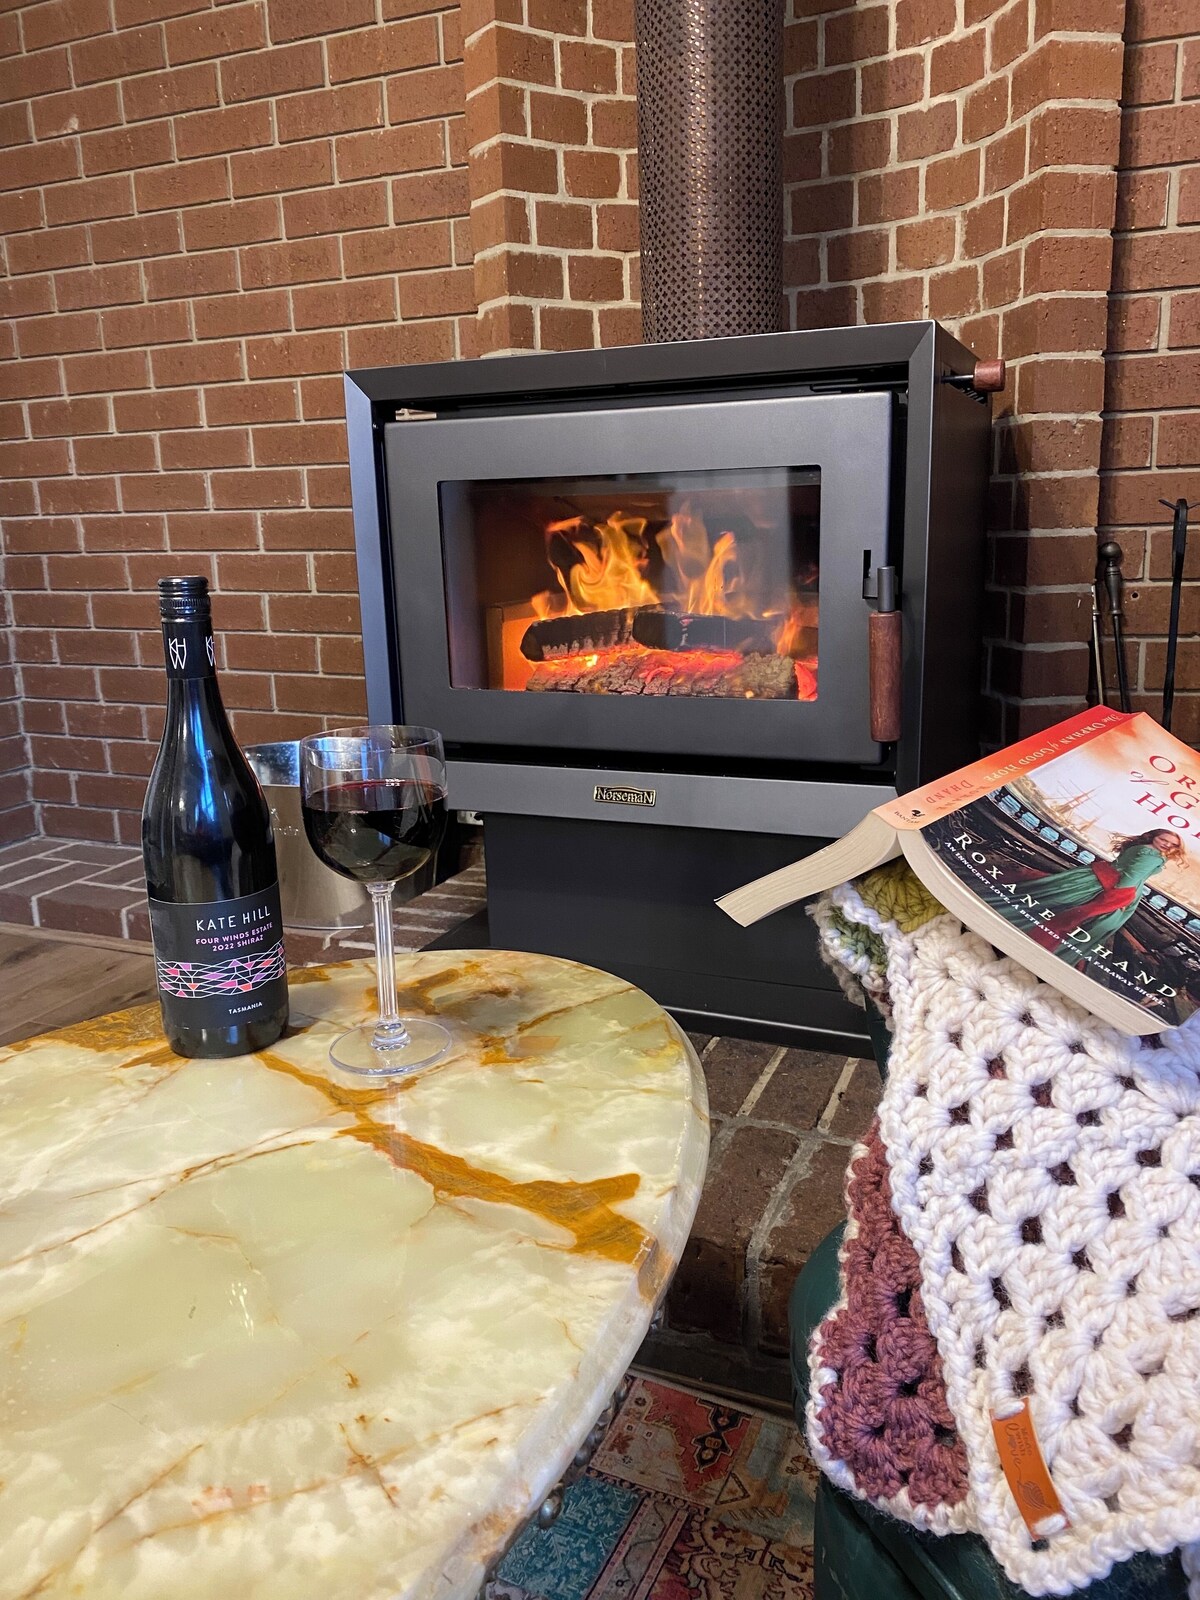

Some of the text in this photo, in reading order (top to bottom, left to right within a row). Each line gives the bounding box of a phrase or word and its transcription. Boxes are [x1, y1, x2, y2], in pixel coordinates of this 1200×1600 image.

[1060, 722, 1106, 745] ORPHAN
[1018, 747, 1055, 766] GOOD
[1048, 741, 1059, 751] of
[984, 764, 1023, 783] HOPE
[1149, 755, 1200, 796] OR
[926, 780, 974, 804] DHAND
[196, 905, 271, 932] KATE HILL
[944, 842, 957, 852] AN
[955, 852, 991, 886] INNOCENT
[1019, 909, 1061, 940] BETRAYED
[1093, 961, 1135, 987] FARAWAY
[1134, 986, 1166, 1008] SHORE.
[953, 832, 1177, 998] ROXANE DHAND
[195, 922, 273, 945] FOUR WINDS ESTATE
[212, 934, 264, 952] 2022 SHIRAZ
[228, 1001, 263, 1015] TASMANIA
